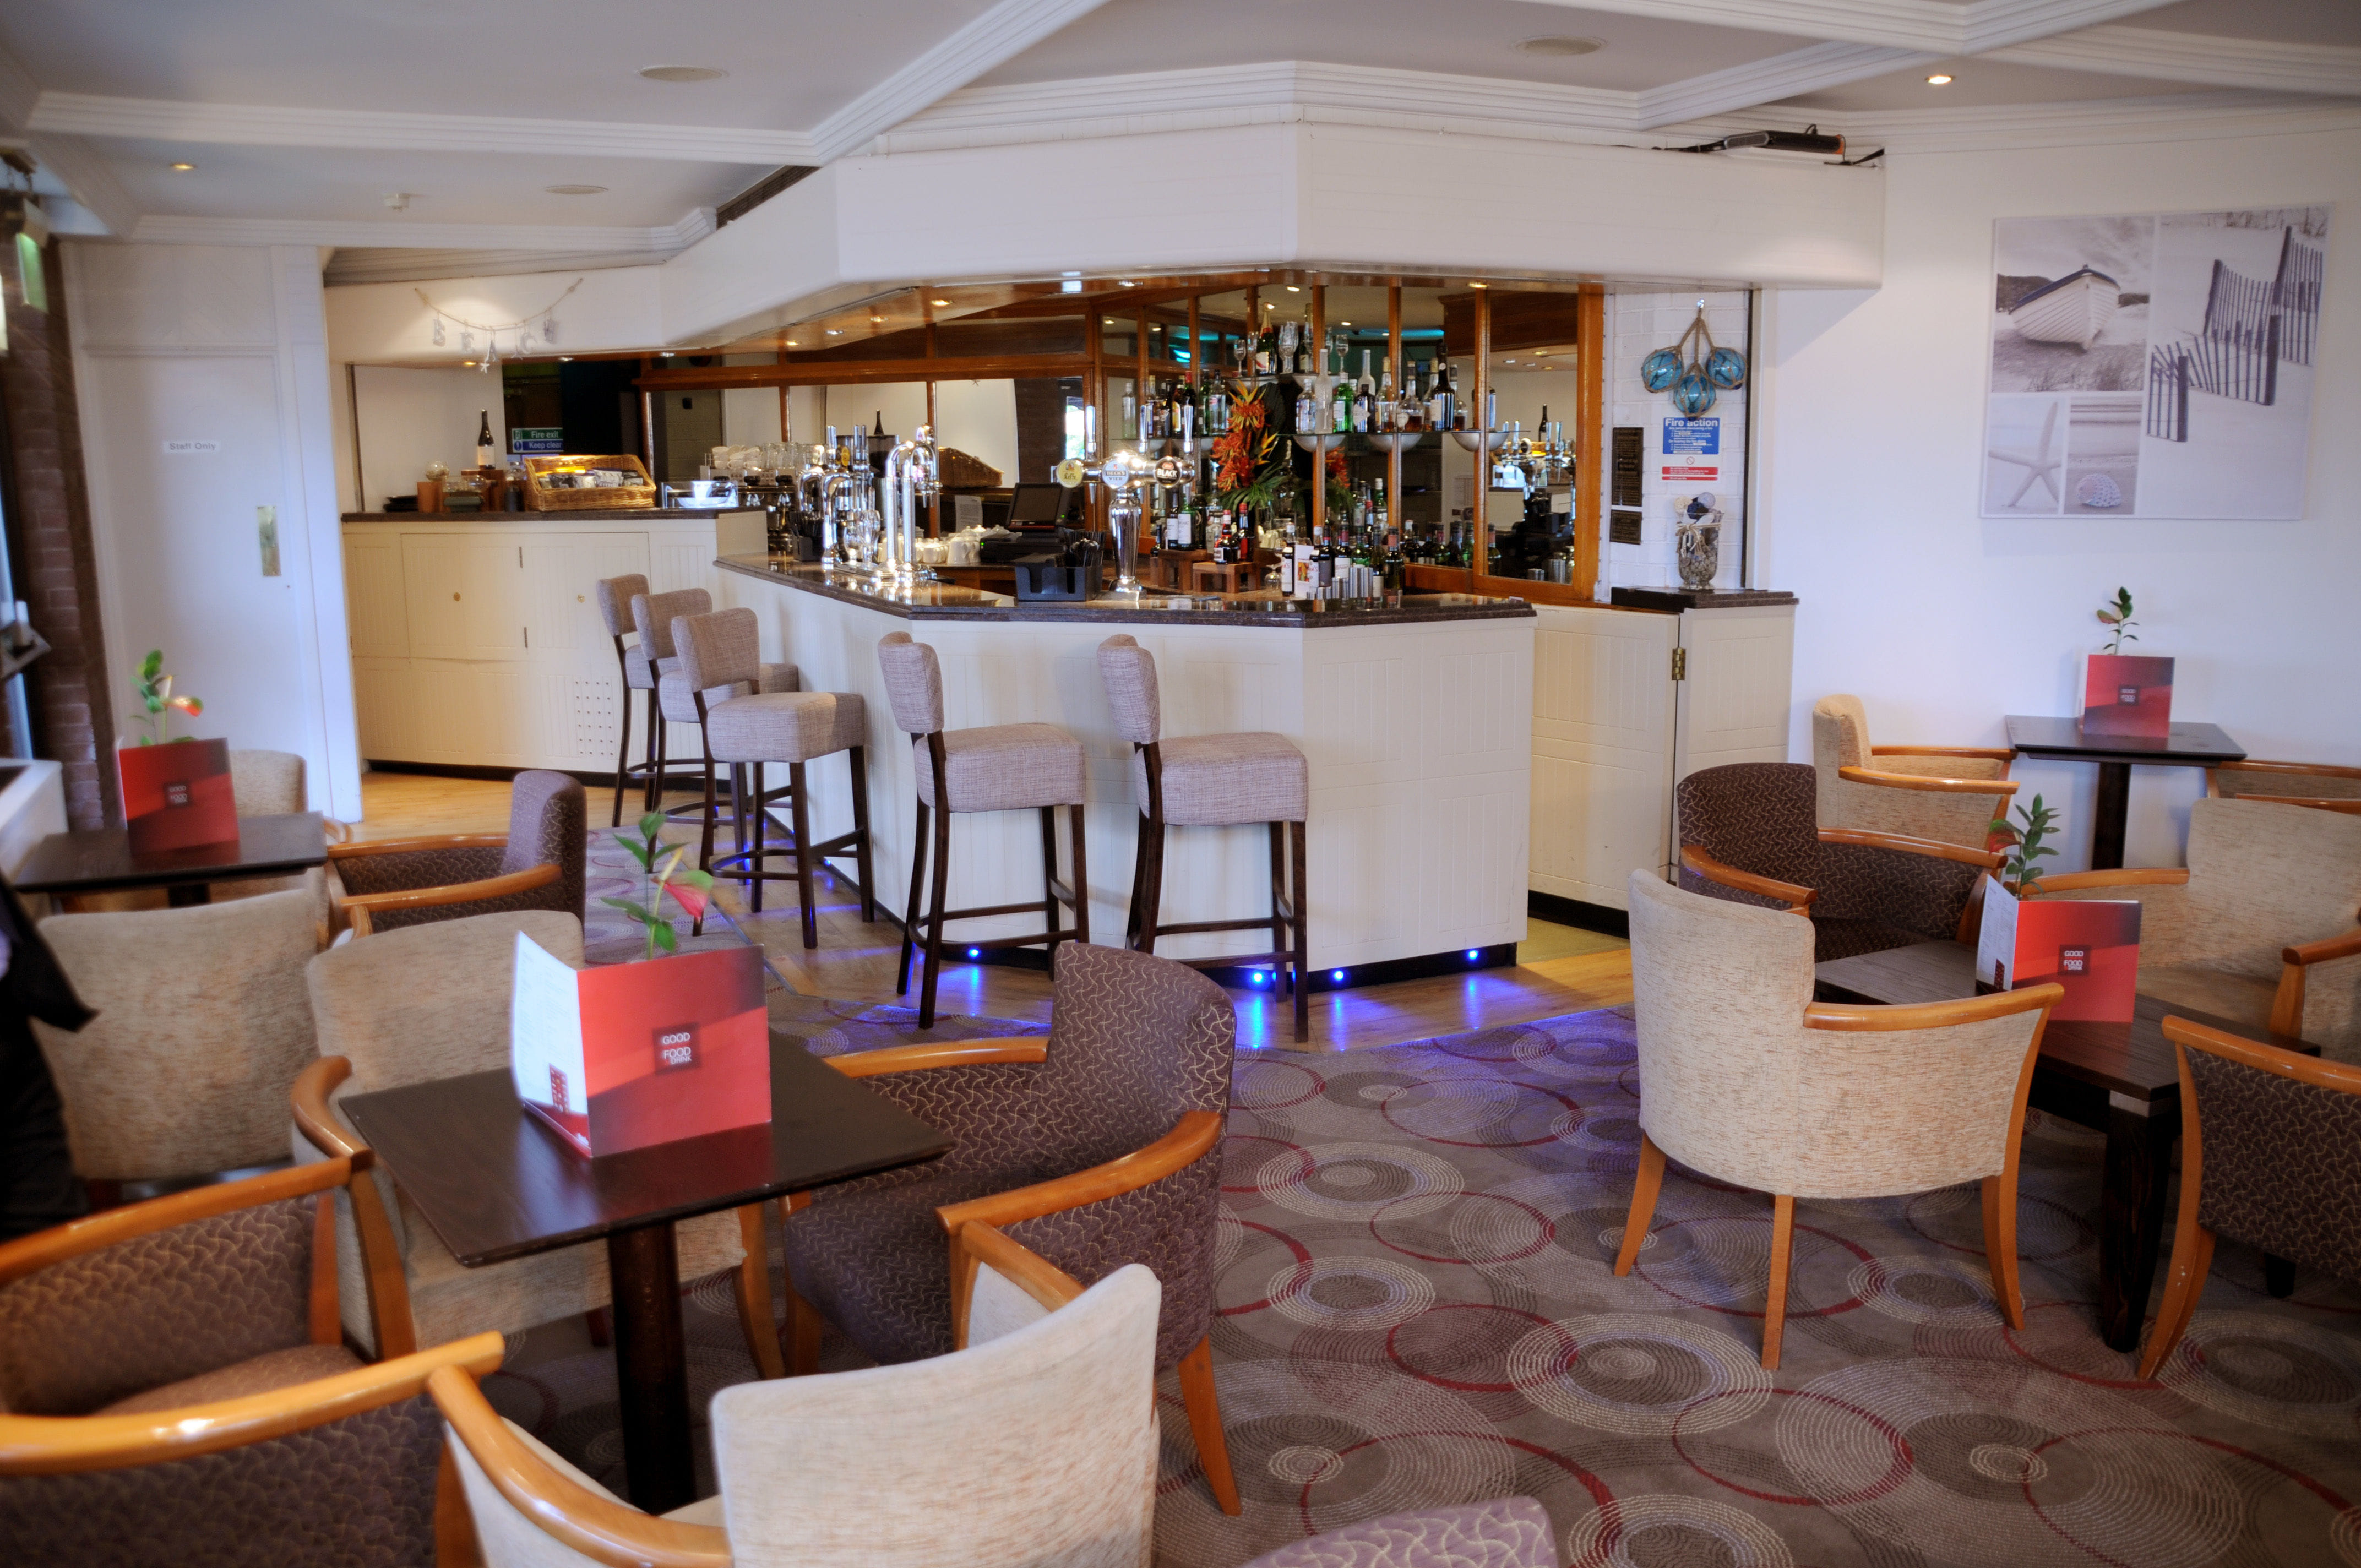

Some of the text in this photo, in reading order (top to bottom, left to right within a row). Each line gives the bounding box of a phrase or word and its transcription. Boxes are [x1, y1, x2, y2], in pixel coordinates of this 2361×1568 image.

[1665, 418, 1718, 427] Fire action
[195, 443, 216, 451] Only
[1157, 468, 1177, 478] BLACK
[662, 1032, 690, 1044] GOOD
[664, 1047, 692, 1059] FOOD
[671, 1055, 692, 1064] DRINK
